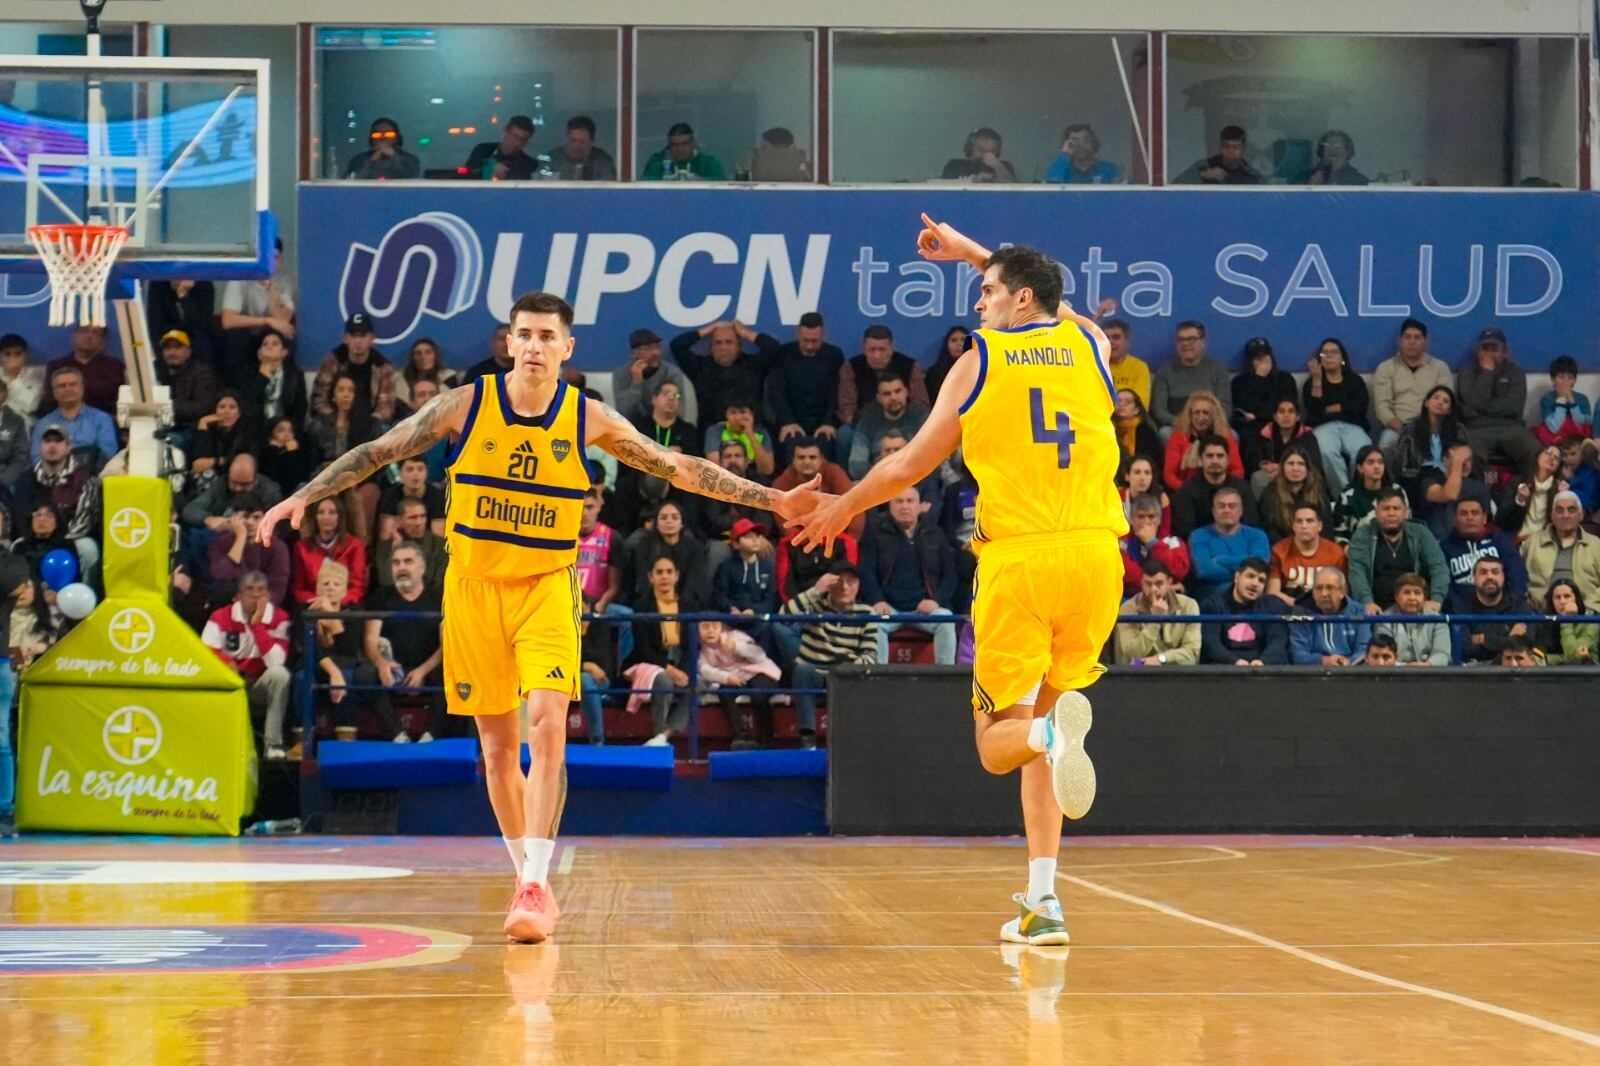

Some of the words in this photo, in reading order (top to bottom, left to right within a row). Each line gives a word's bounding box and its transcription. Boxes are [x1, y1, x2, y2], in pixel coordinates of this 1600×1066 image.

[487, 232, 831, 327] UPCN
[852, 243, 1173, 317] tarta
[1211, 243, 1563, 317] SALUD
[1005, 347, 1074, 366] MAINOLDI
[1029, 388, 1076, 469] 4
[507, 453, 538, 480] 20
[476, 496, 557, 531] Chiquita
[56, 657, 117, 679] siempre
[121, 656, 140, 673] de
[143, 657, 161, 675] tu
[164, 657, 202, 676] lado
[80, 768, 219, 815] esquina
[173, 808, 184, 818] de
